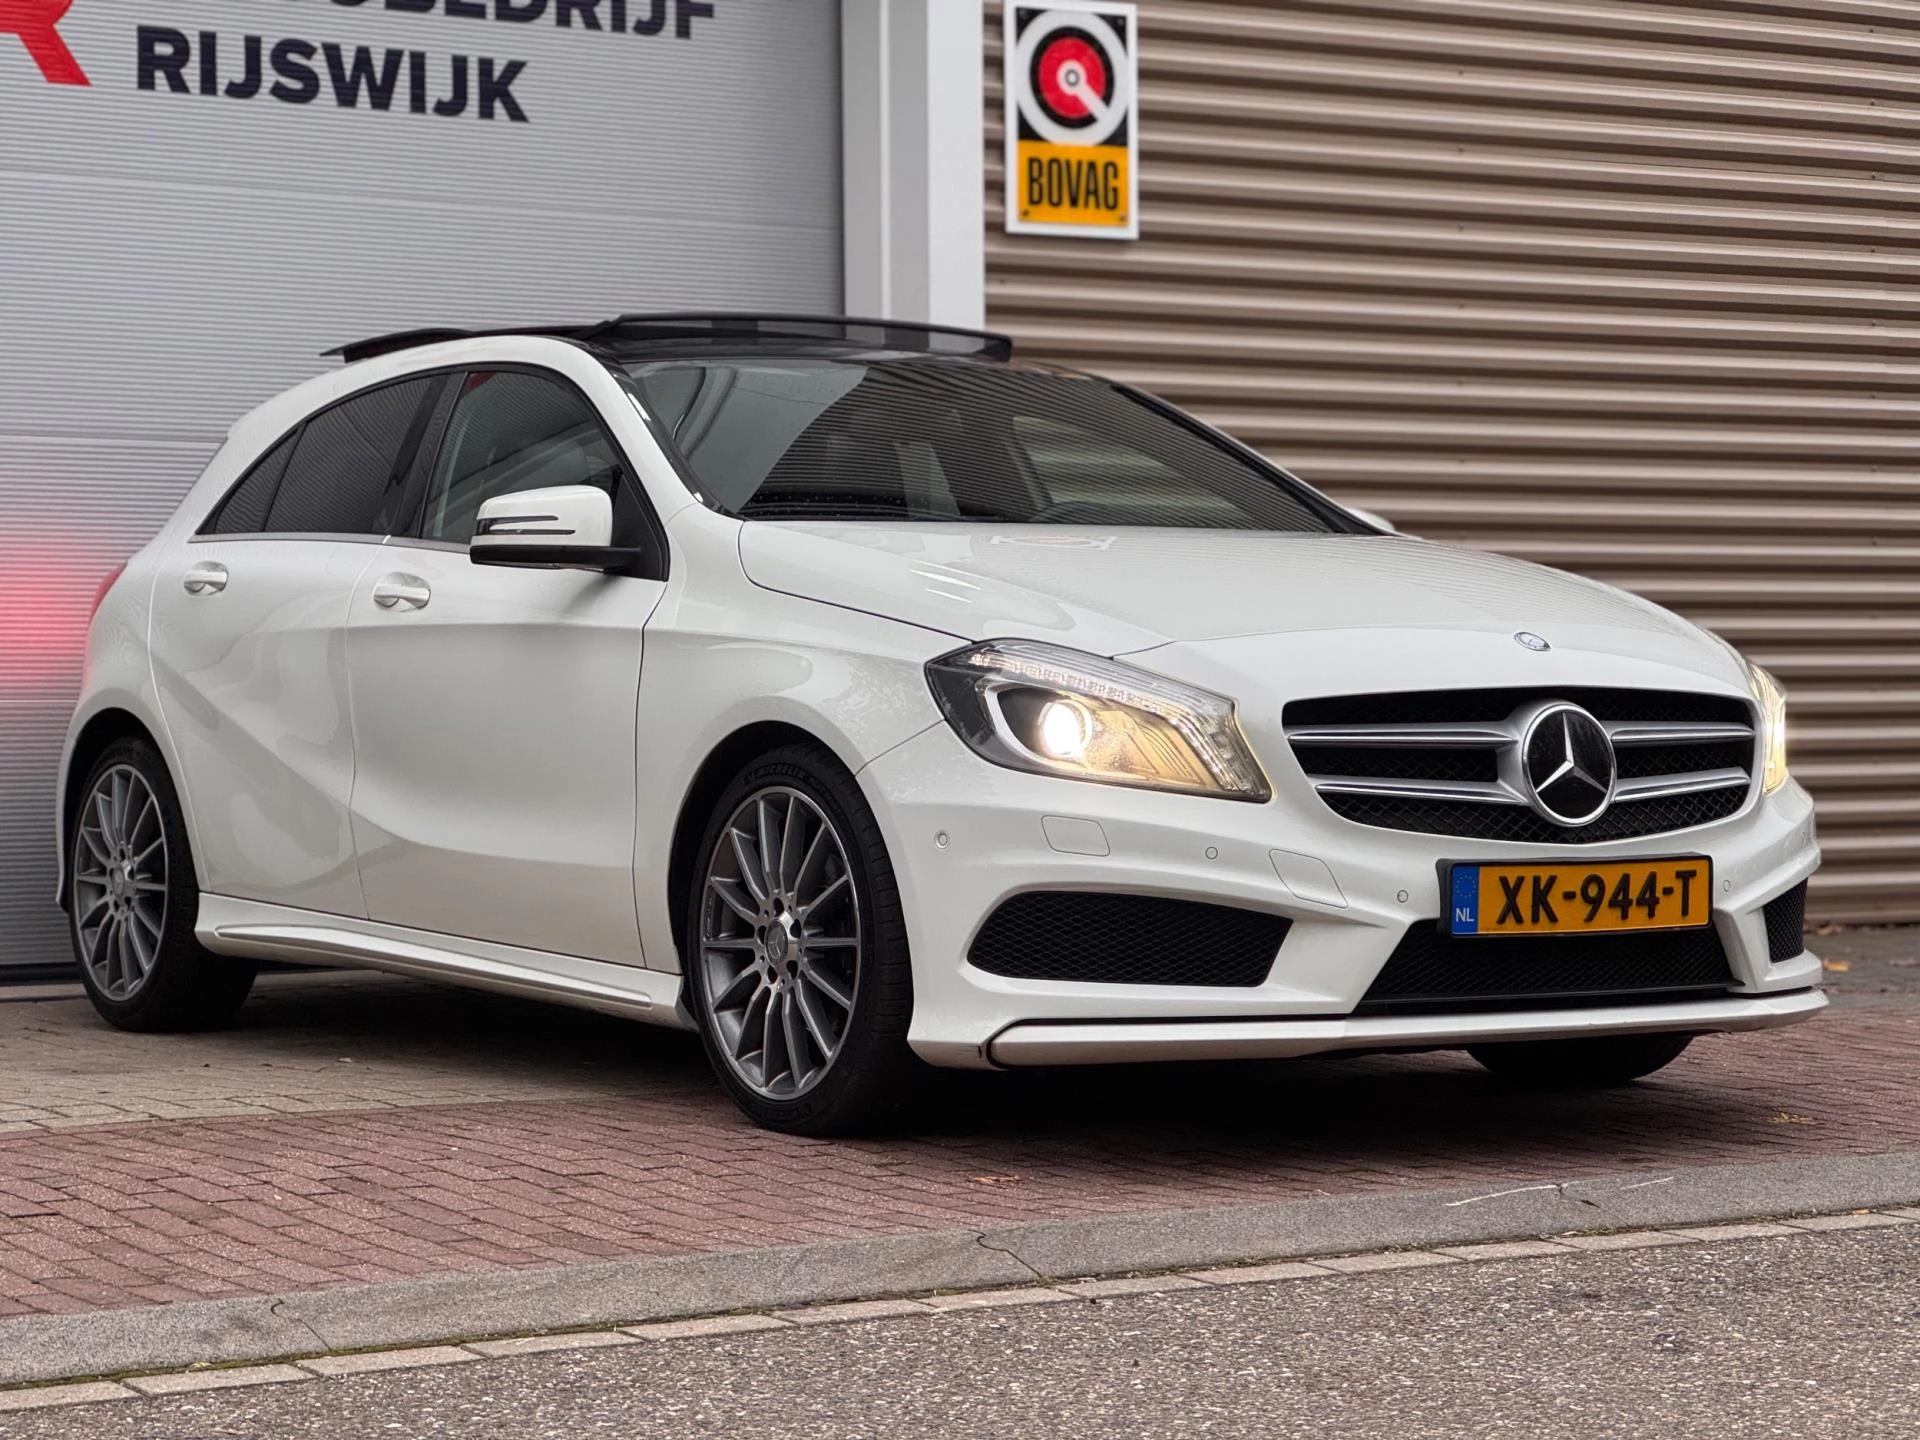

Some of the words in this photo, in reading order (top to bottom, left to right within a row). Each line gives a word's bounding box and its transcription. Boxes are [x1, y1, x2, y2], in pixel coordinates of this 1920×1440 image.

[136, 25, 530, 122] RIJSWIJK
[1028, 157, 1119, 211] BOVAG
[1455, 907, 1475, 923] NL
[1496, 869, 1697, 925] XK-944-T
